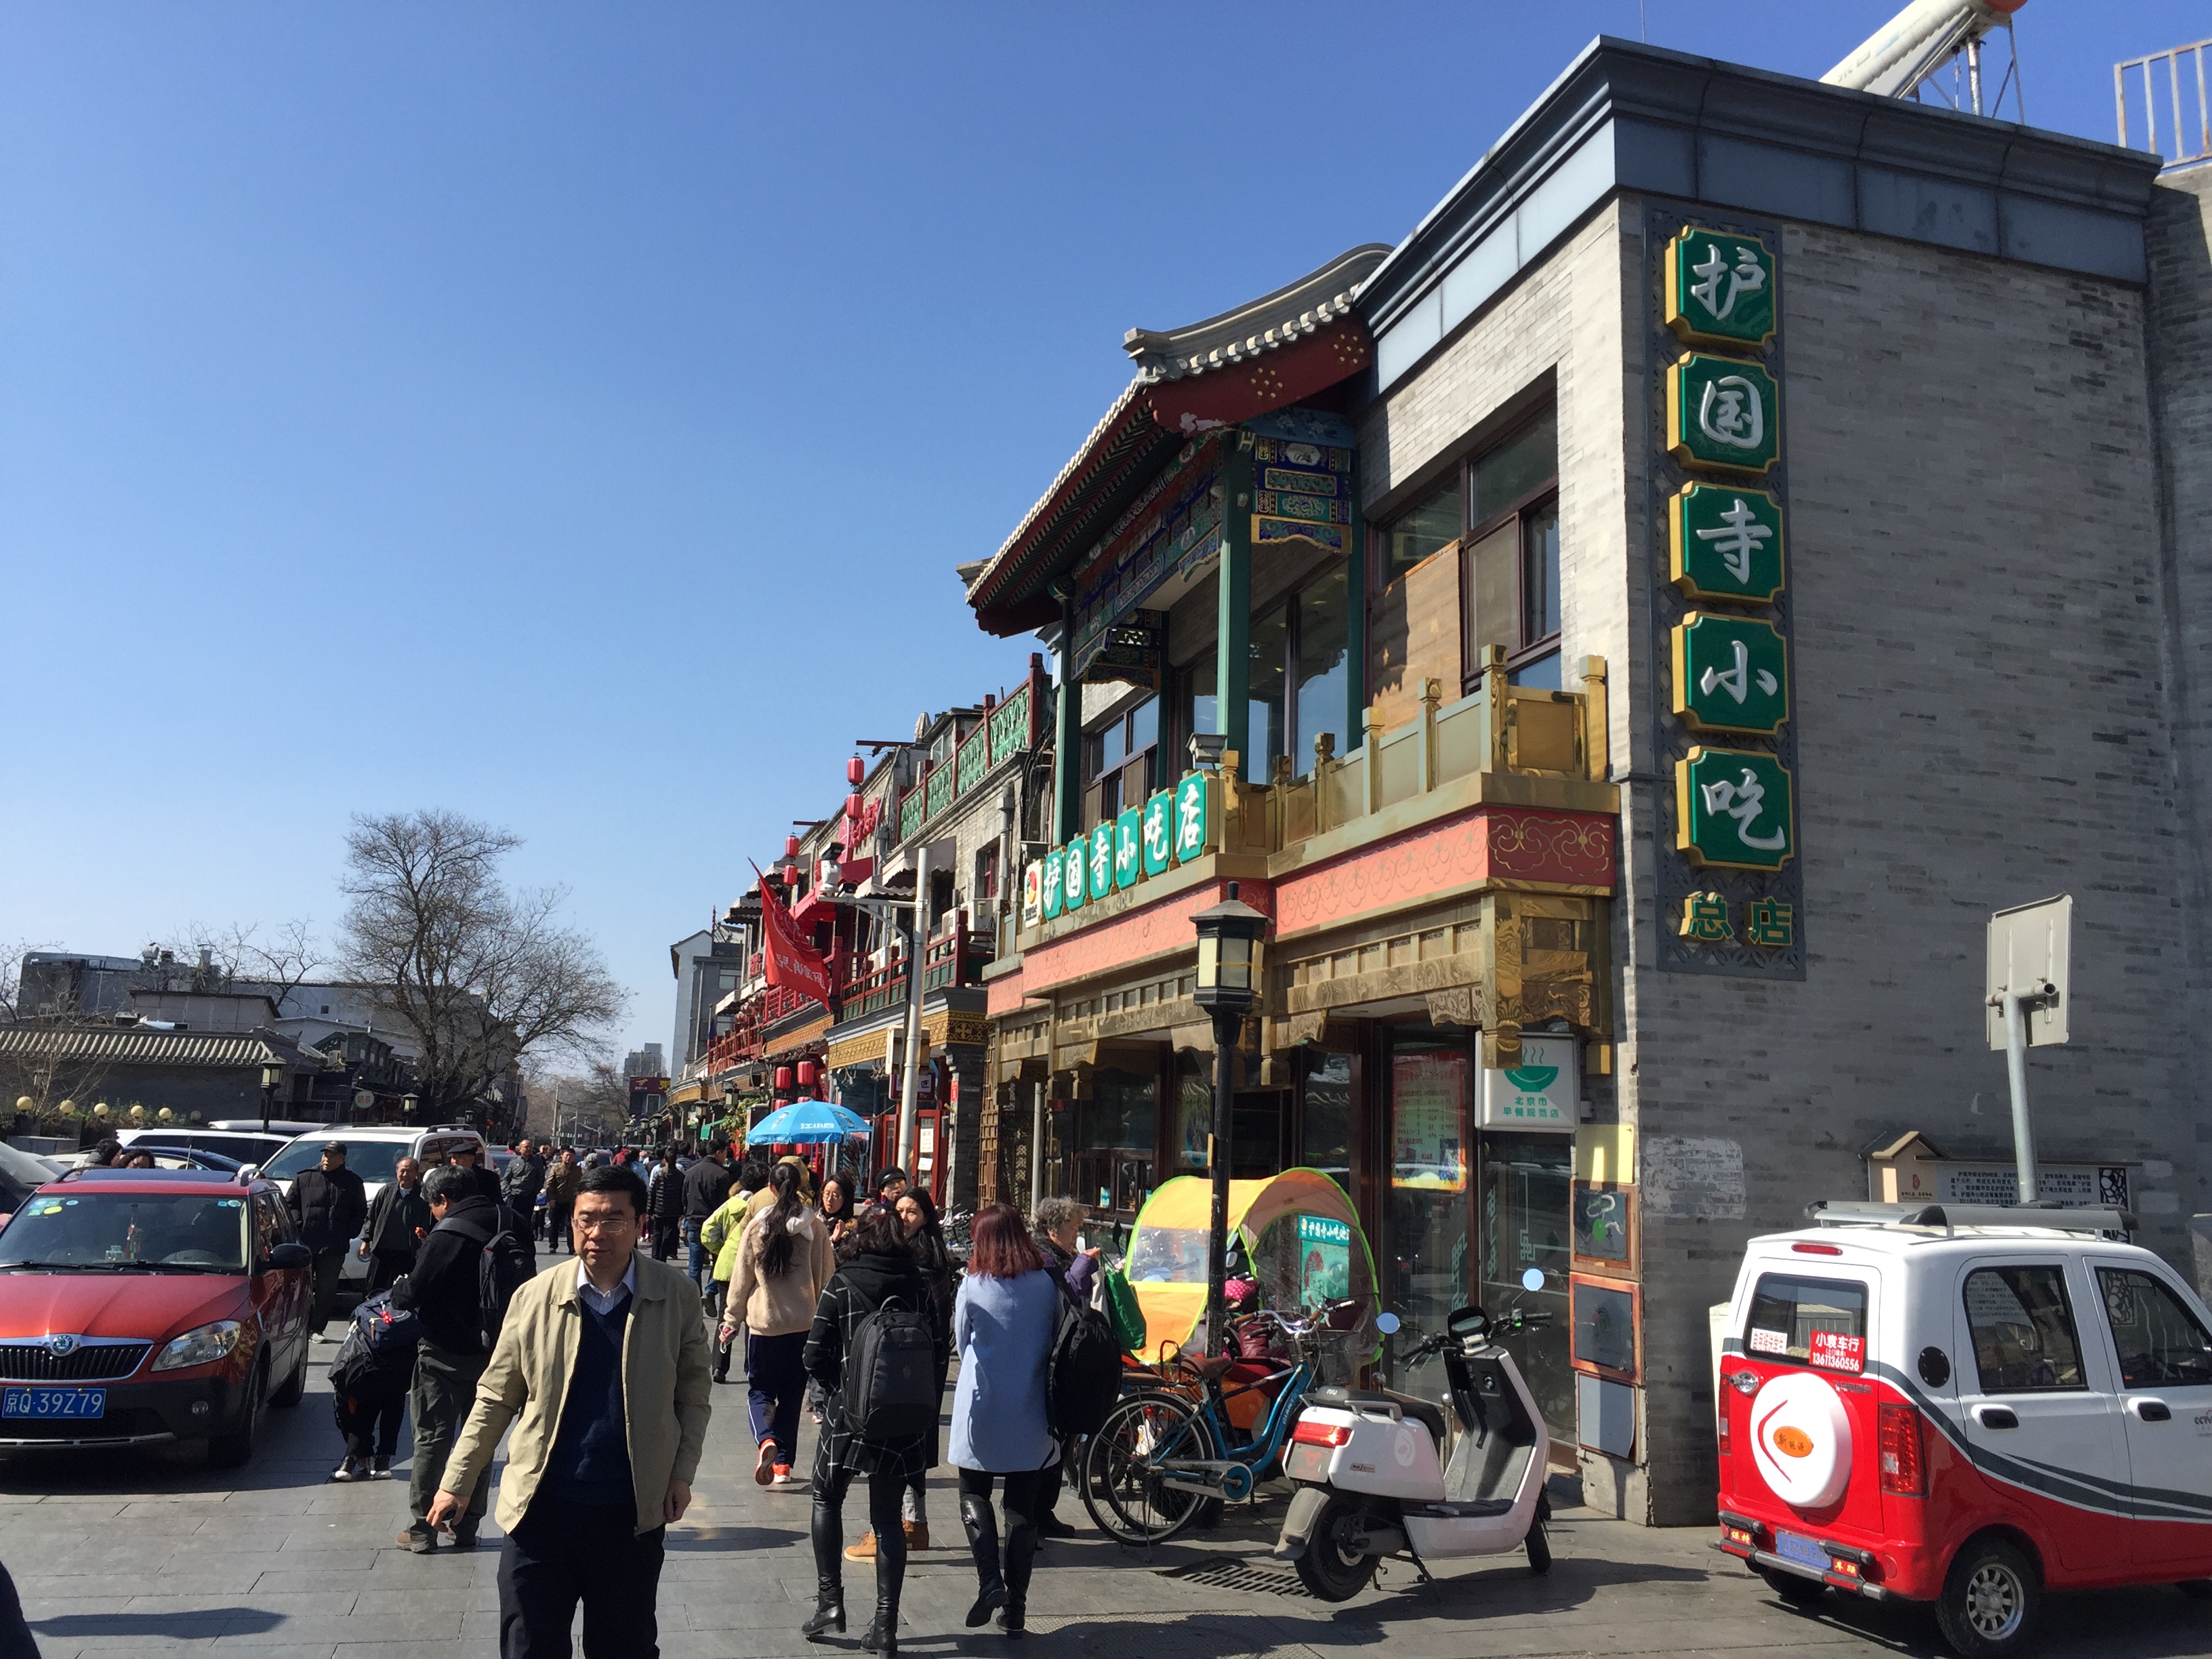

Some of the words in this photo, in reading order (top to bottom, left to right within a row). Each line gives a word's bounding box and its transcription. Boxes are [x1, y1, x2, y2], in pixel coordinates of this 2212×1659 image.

[1691, 244, 1786, 851] 护国寺小吃
[1043, 783, 1201, 912] 护国寺小吃店
[1681, 891, 1793, 945] 总店
[1515, 1096, 1547, 1106] 北京市
[1503, 1107, 1559, 1118] 早餐规范店
[1816, 1333, 1860, 1352] 小袁车行
[1812, 1352, 1860, 1372] 13611360556
